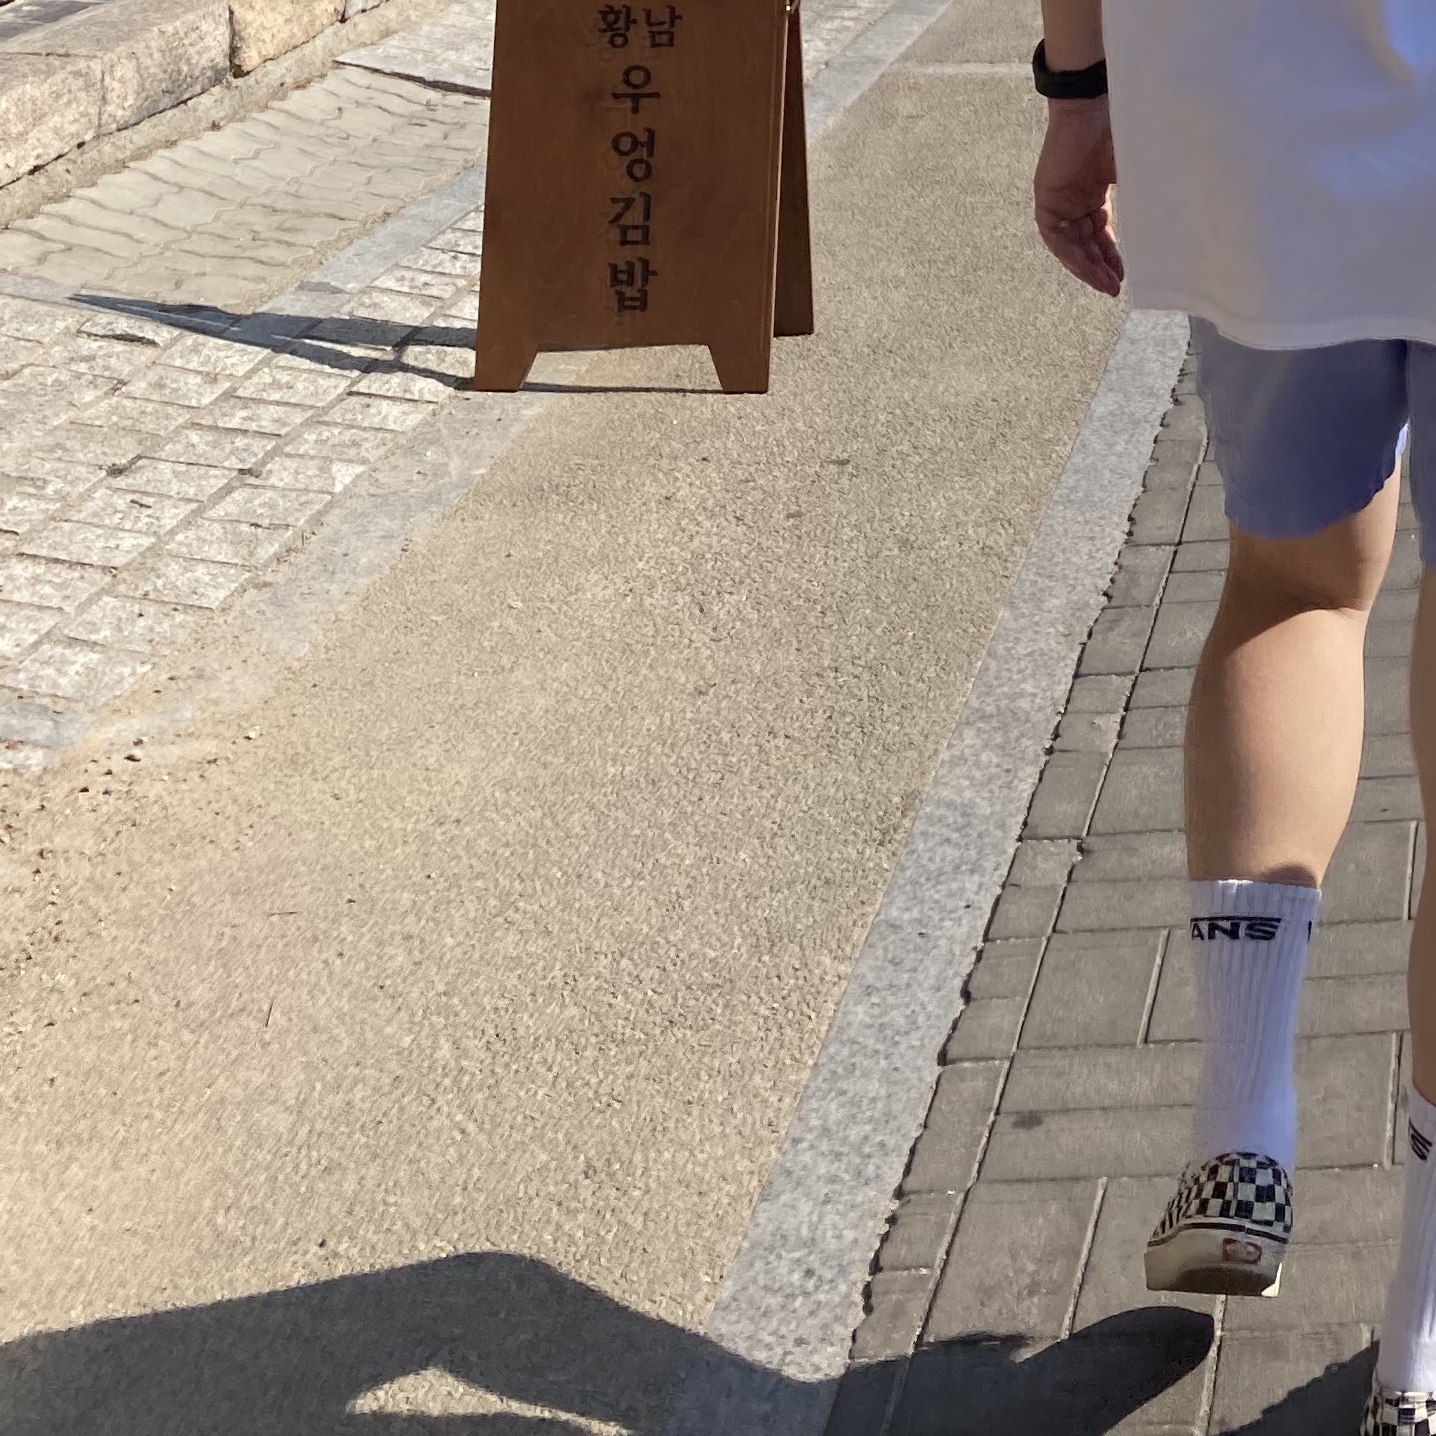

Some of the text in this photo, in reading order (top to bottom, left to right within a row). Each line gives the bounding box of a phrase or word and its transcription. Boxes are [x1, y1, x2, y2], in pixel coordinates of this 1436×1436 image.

[597, 4, 682, 49] 황남
[607, 64, 661, 313] 우엉김밥
[1190, 916, 1281, 941] ANS
